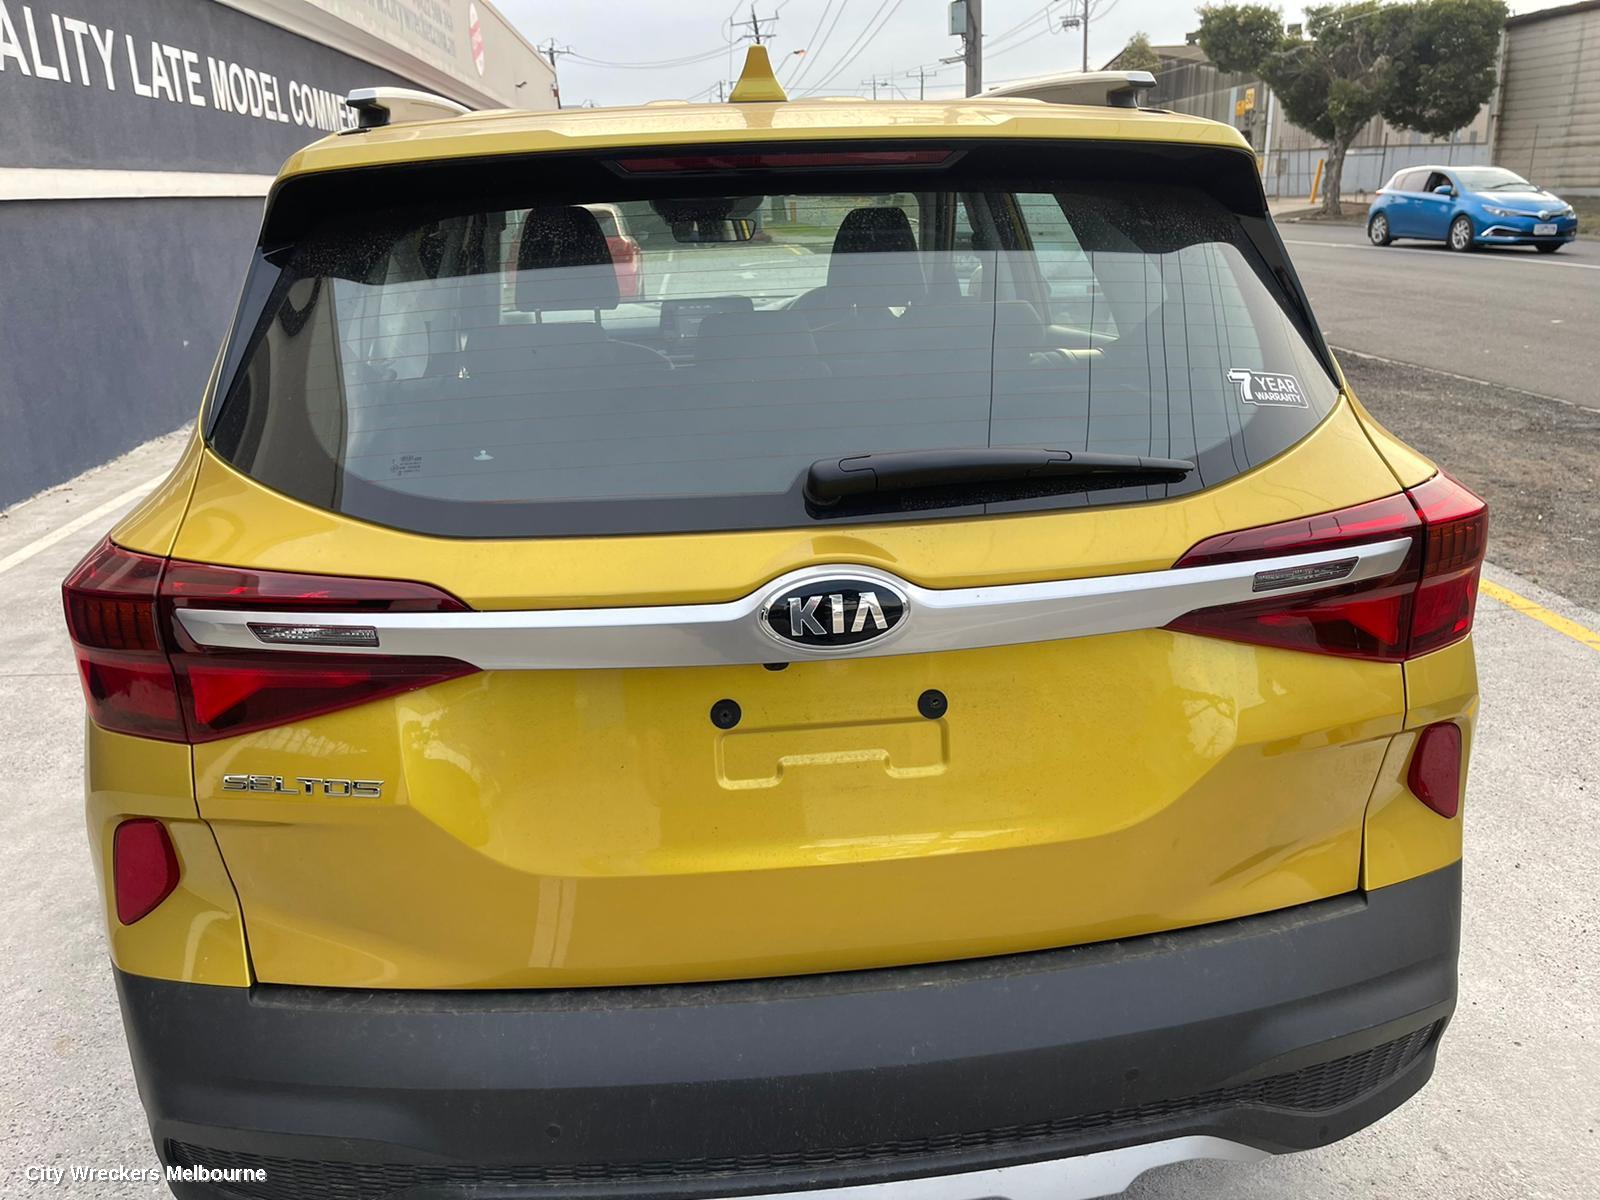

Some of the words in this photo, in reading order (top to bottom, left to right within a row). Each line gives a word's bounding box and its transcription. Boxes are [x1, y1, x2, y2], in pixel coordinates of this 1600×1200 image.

[0, 0, 115, 91] ALITY
[125, 34, 206, 107] LATE
[207, 56, 289, 123] MODEL
[1228, 371, 1253, 400] 7
[1254, 376, 1297, 393] YEAR
[1254, 391, 1302, 403] WARRANTY
[787, 591, 889, 637] KIA
[222, 773, 385, 798] SELTOS
